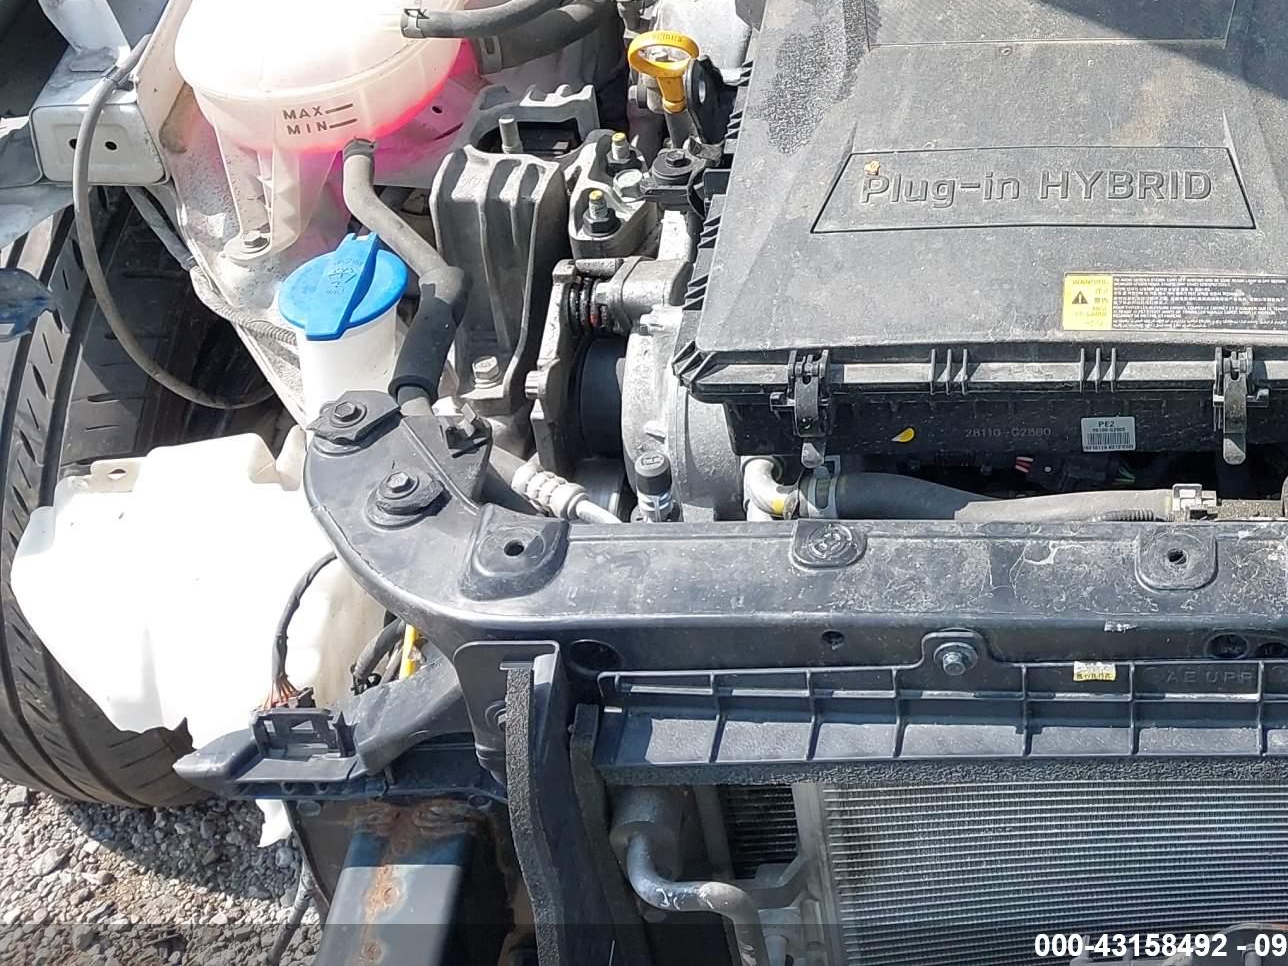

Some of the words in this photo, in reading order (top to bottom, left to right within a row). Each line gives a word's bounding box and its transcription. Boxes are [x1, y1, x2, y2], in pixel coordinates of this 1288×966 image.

[282, 105, 324, 121] MAX
[286, 120, 328, 136] MIN
[860, 170, 1021, 209] Plug-in
[1039, 169, 1213, 201] HYBRID
[1098, 420, 1116, 428] PE2
